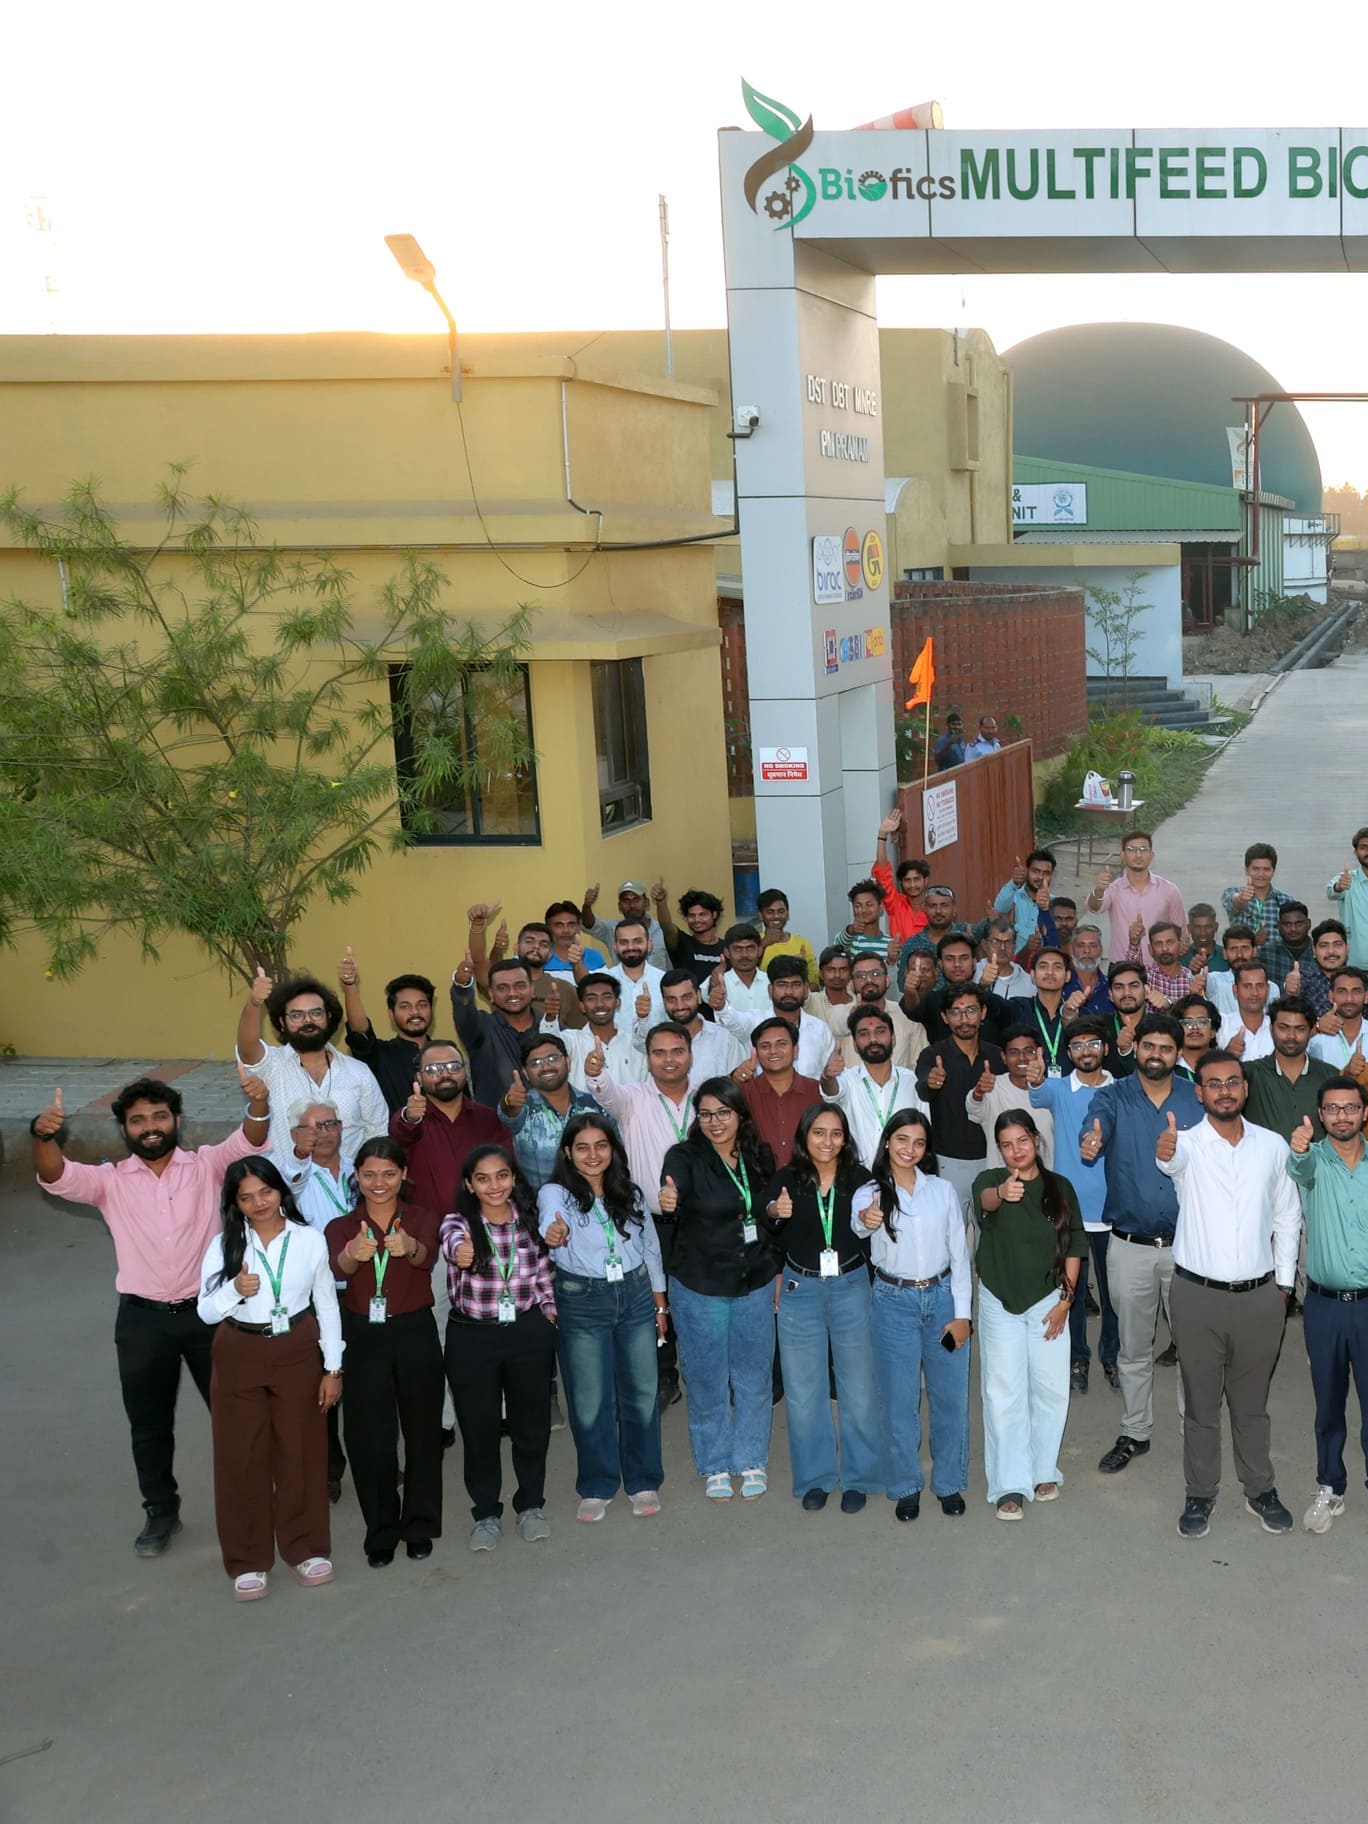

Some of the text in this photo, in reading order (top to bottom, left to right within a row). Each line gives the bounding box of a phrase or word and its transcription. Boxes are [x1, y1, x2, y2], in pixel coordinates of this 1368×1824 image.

[818, 167, 957, 201] Biofics
[960, 146, 1268, 200] MULTIFEED
[806, 374, 826, 405] DST
[830, 379, 849, 411] DBT
[1012, 488, 1022, 502] &
